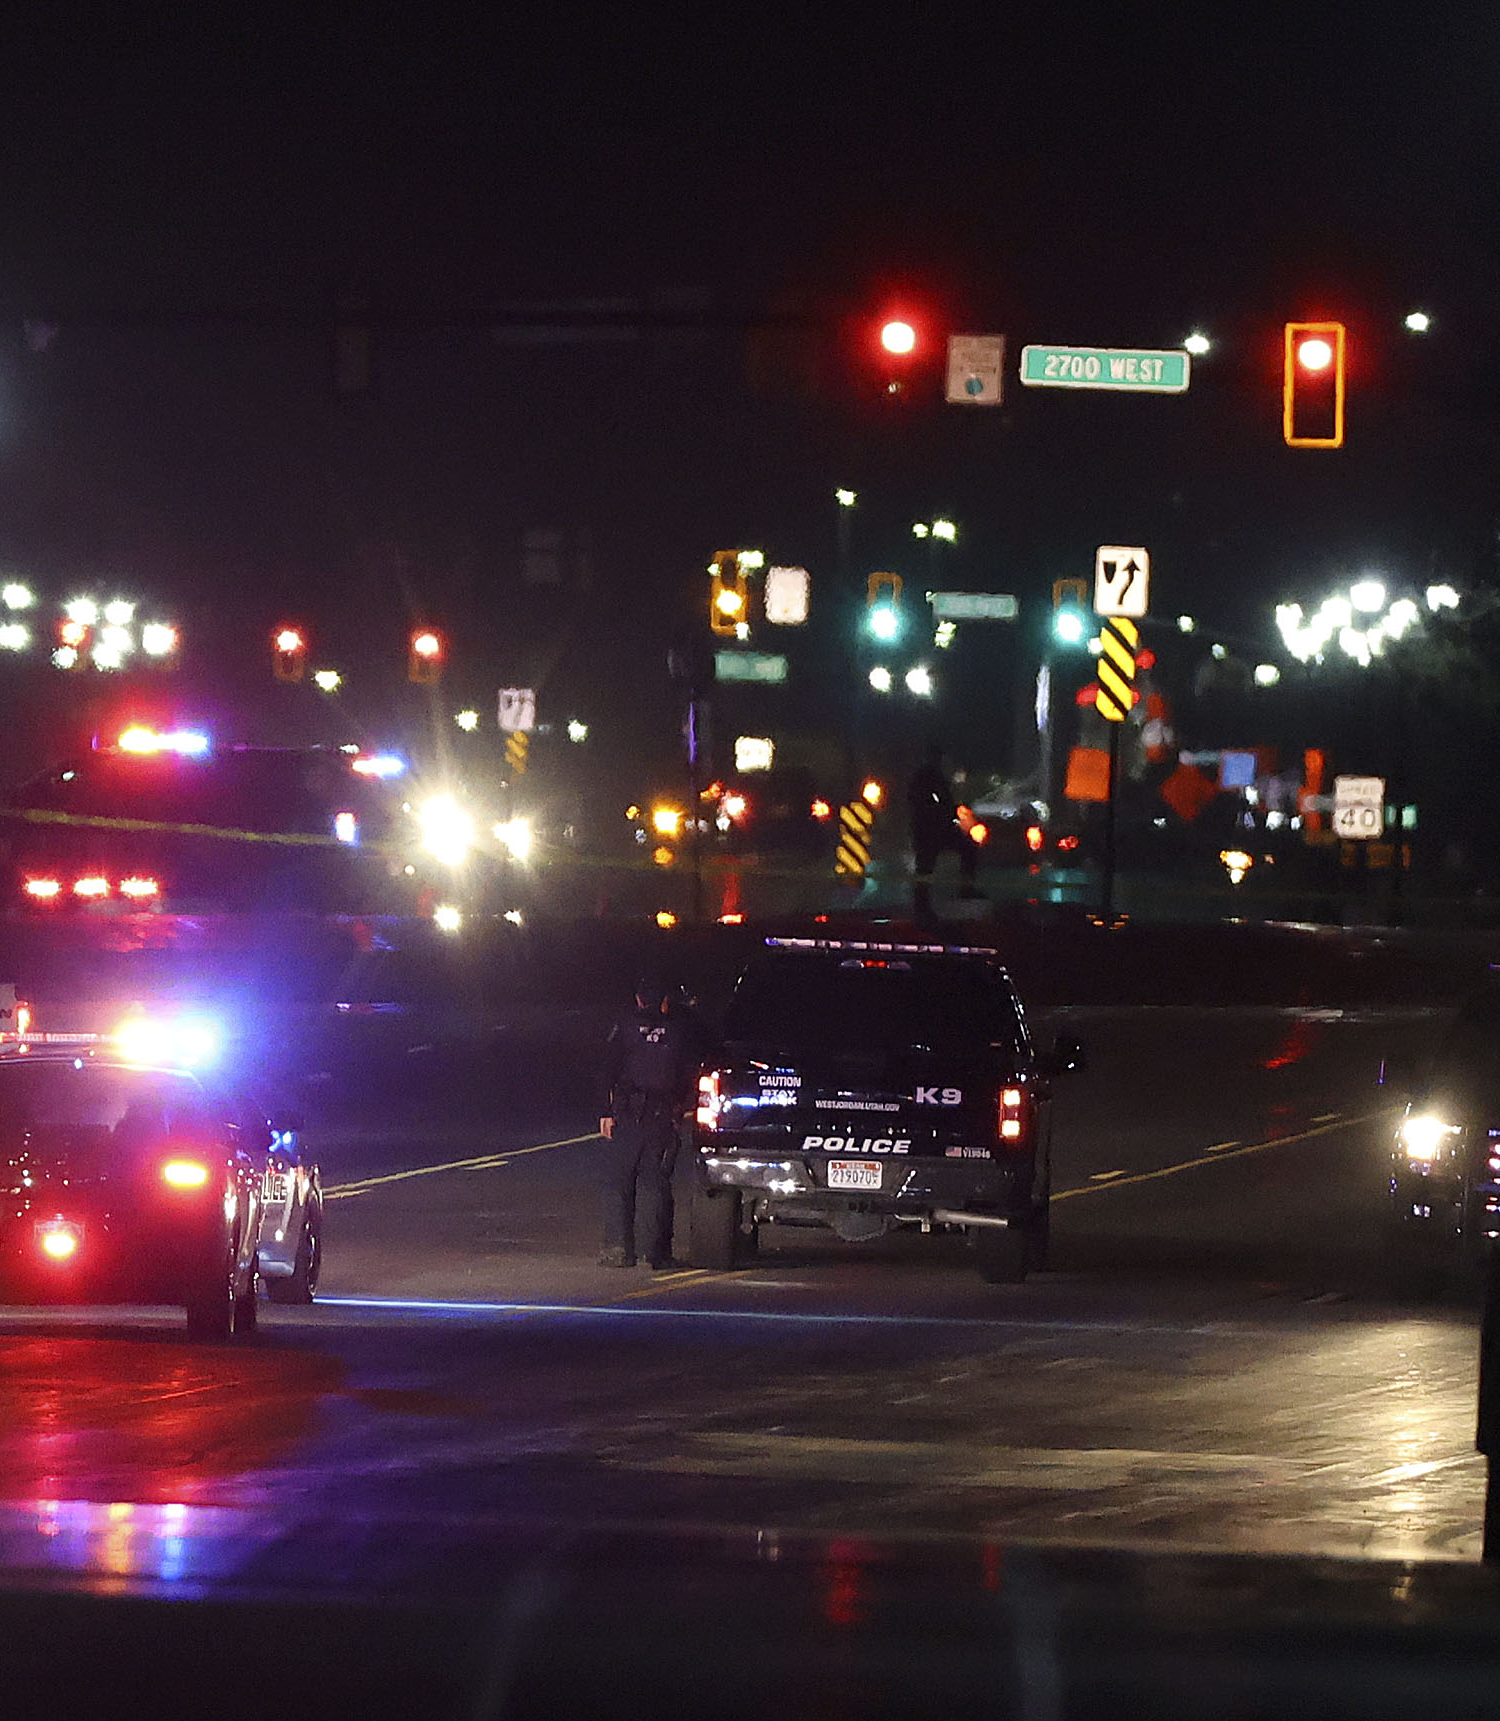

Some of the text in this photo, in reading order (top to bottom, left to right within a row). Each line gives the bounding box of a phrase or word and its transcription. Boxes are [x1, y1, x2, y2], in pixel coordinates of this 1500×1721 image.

[1044, 354, 1164, 382] 2700 WEST
[1341, 808, 1375, 828] 40
[759, 1075, 802, 1087] CAUTION
[916, 1086, 962, 1105] K9
[802, 1136, 912, 1154] POLICE
